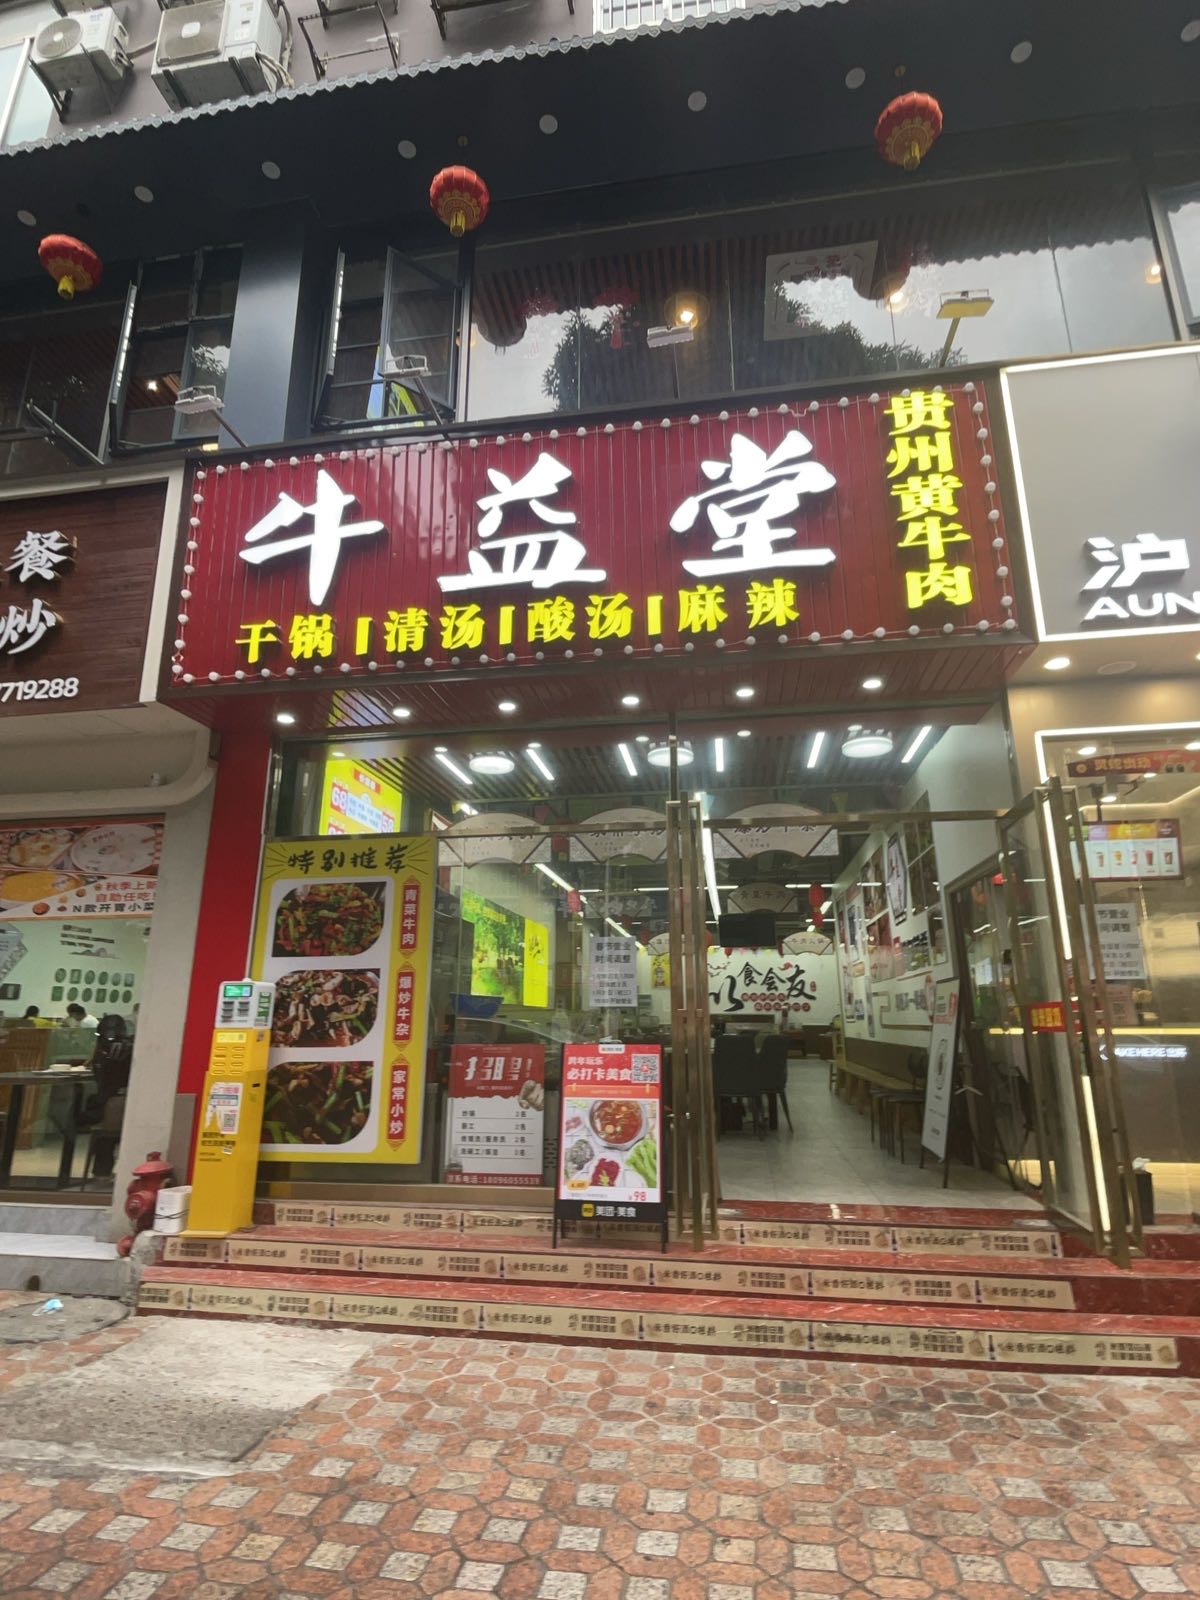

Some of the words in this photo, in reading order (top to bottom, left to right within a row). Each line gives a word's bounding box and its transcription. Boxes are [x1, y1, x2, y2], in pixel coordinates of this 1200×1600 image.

[239, 429, 837, 607] 牛益堂
[887, 391, 973, 609] 贵州黄牛肉
[1082, 532, 1191, 590] 沪
[287, 844, 409, 875] 特别推荐
[388, 1068, 405, 1137] 家常小炒
[567, 1067, 632, 1081] 必打卡美食
